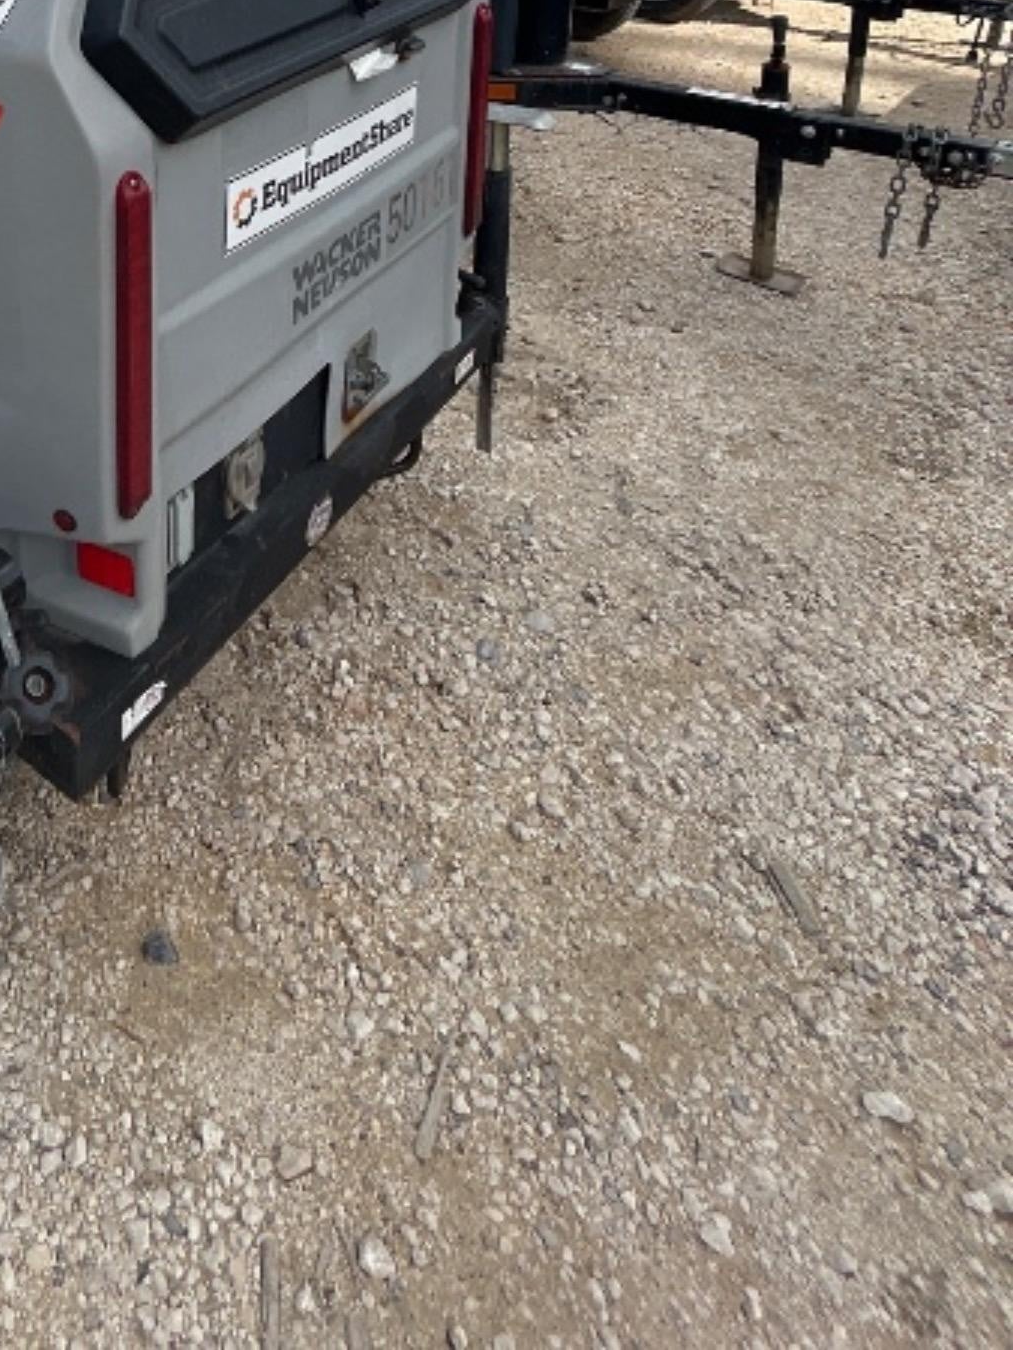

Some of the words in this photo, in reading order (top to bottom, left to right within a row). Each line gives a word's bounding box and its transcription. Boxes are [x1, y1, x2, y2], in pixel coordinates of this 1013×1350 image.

[261, 108, 414, 210] EquipmentShare
[292, 210, 381, 291] WACKER
[292, 236, 382, 325] NEUSON
